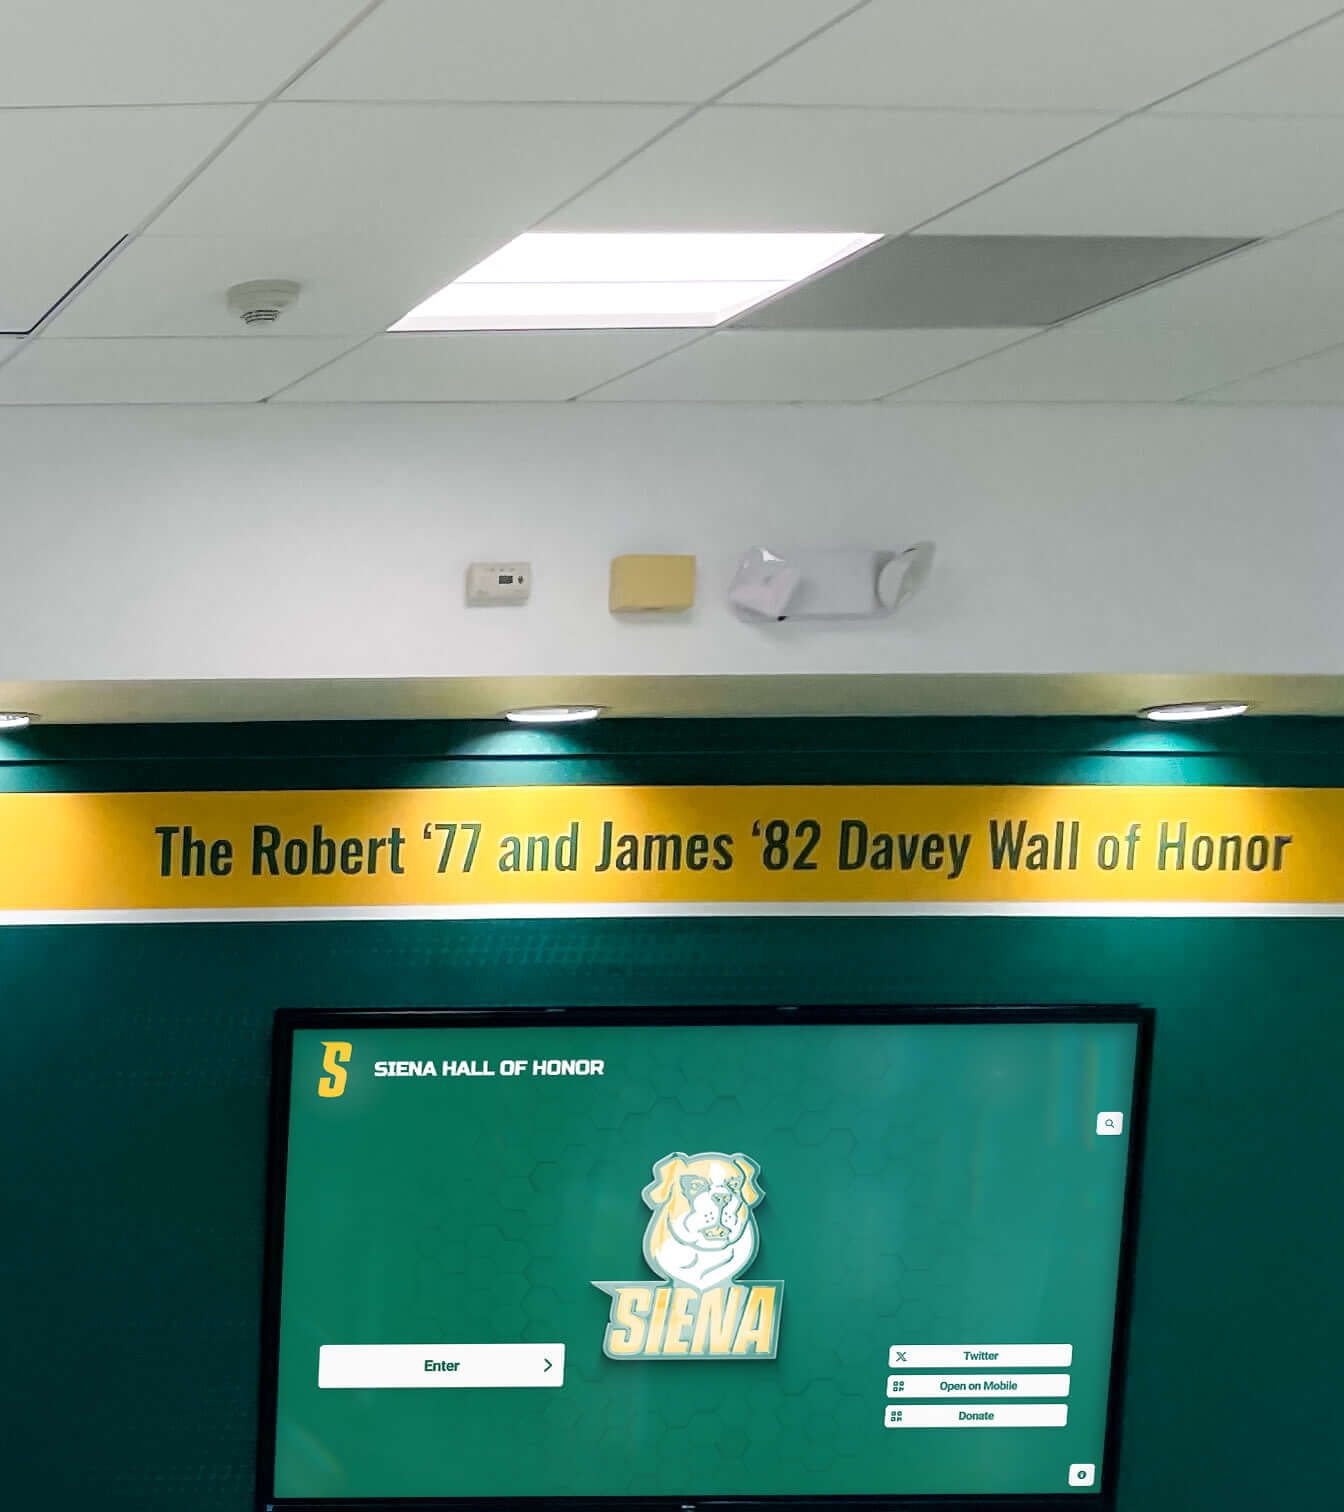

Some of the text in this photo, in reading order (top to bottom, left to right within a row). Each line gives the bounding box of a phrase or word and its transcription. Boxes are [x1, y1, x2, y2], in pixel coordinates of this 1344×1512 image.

[155, 819, 1292, 879] The Robert ‘77 and James ‘82 Davey Wall of Honor
[318, 1041, 352, 1098] S
[374, 1059, 604, 1076] SIENA HALL OF HONOR
[610, 1287, 776, 1353] SIENA
[963, 1351, 999, 1361] Twitter
[424, 1360, 460, 1372] Enter
[940, 1382, 966, 1392] Open
[984, 1380, 1017, 1390] Mobile
[958, 1411, 994, 1420] Donate
